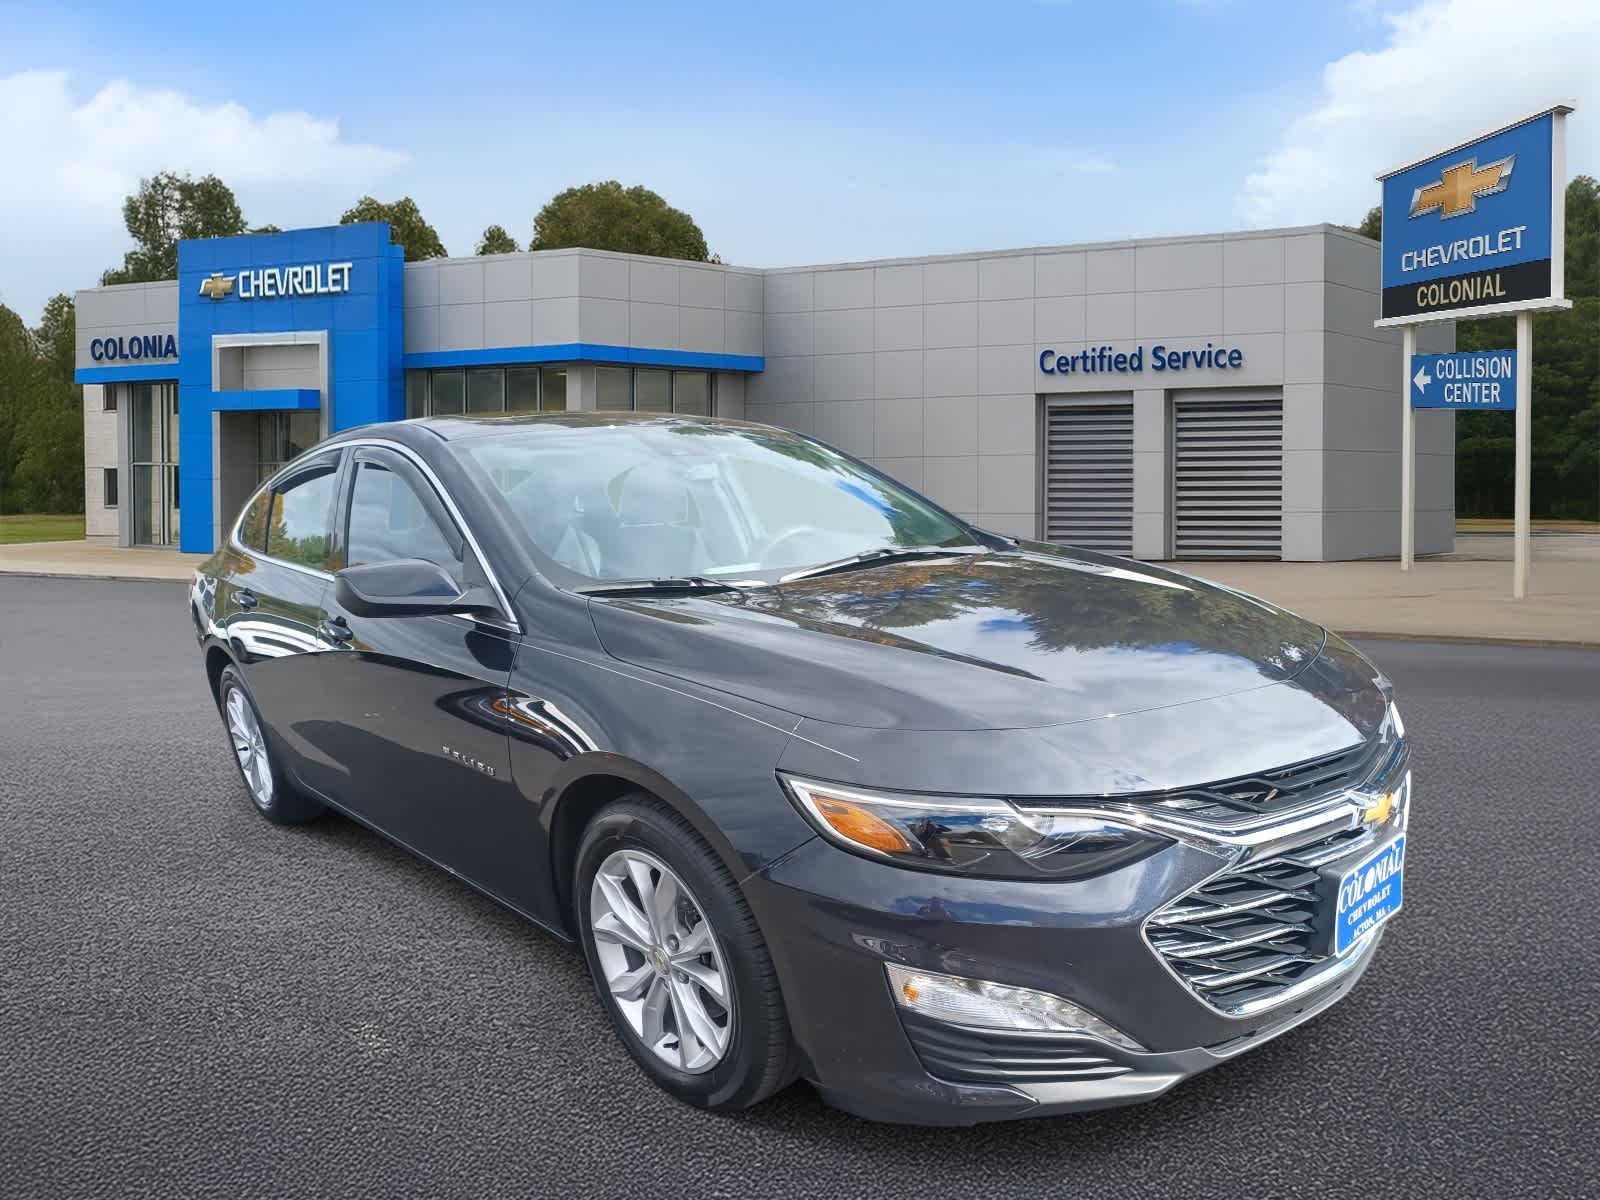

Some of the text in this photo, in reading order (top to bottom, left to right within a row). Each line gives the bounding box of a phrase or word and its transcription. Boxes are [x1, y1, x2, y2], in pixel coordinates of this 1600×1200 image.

[1401, 225, 1528, 272] CHEVROLET
[239, 262, 353, 298] CHEVROLET
[1416, 273, 1506, 308] COLONIAL
[1039, 343, 1243, 374] Certified Service
[1436, 357, 1511, 379] COLLISION
[1444, 382, 1501, 404] CENTER
[1339, 844, 1402, 914] COLONIAL
[1347, 884, 1392, 926] CHEVROLET
[1375, 909, 1386, 920] MA
